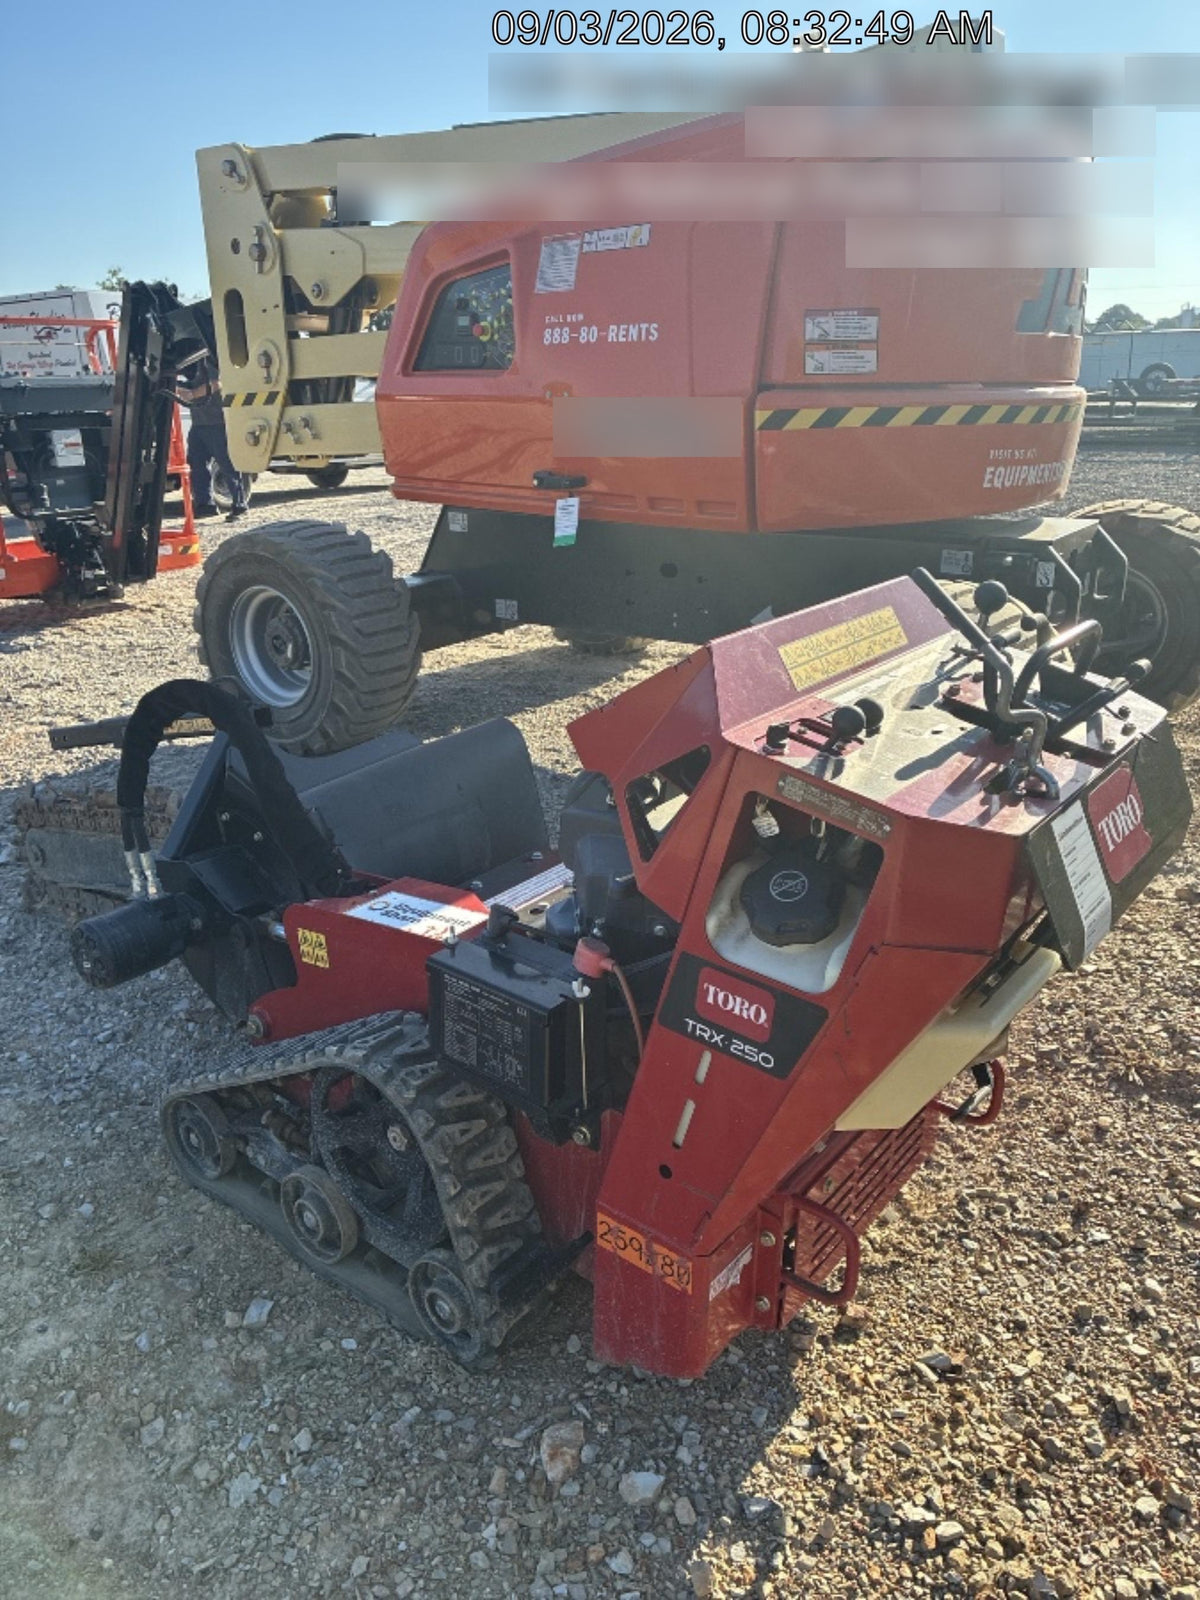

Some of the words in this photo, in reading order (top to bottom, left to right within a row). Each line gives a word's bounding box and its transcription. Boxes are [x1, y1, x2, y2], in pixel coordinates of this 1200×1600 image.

[543, 323, 659, 345] 888-80-RENTS
[1098, 794, 1142, 852] TORO
[703, 982, 768, 1026] TORO
